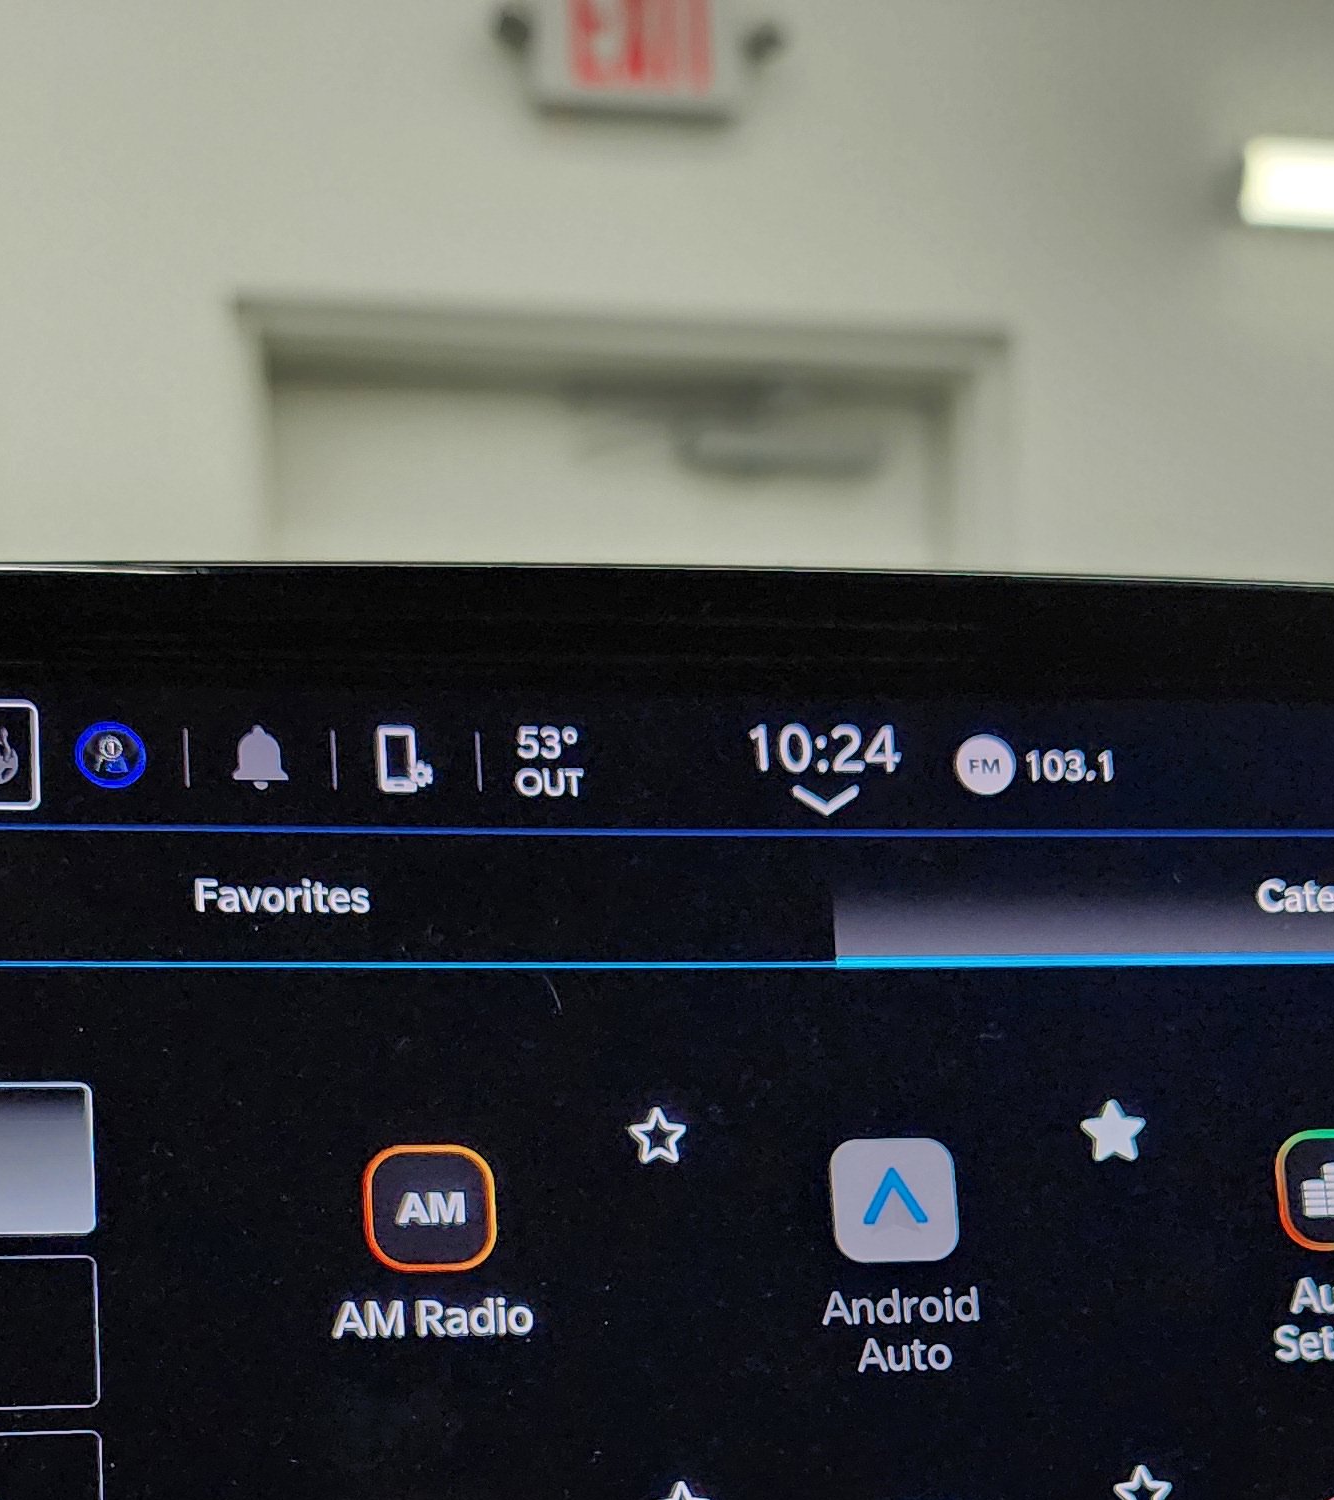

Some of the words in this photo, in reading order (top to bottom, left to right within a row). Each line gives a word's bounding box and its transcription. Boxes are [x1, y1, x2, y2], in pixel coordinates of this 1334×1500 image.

[515, 725, 579, 761] 53°
[748, 722, 903, 775] 10:24
[514, 767, 584, 799] OUT
[969, 757, 1002, 776] FM
[1025, 748, 1115, 783] 103.1
[193, 876, 372, 916] Favorites
[394, 1190, 467, 1227] AM
[331, 1300, 405, 1341] AM
[414, 1295, 535, 1338] Radio
[821, 1285, 982, 1327] Android
[856, 1336, 954, 1374] Auto
